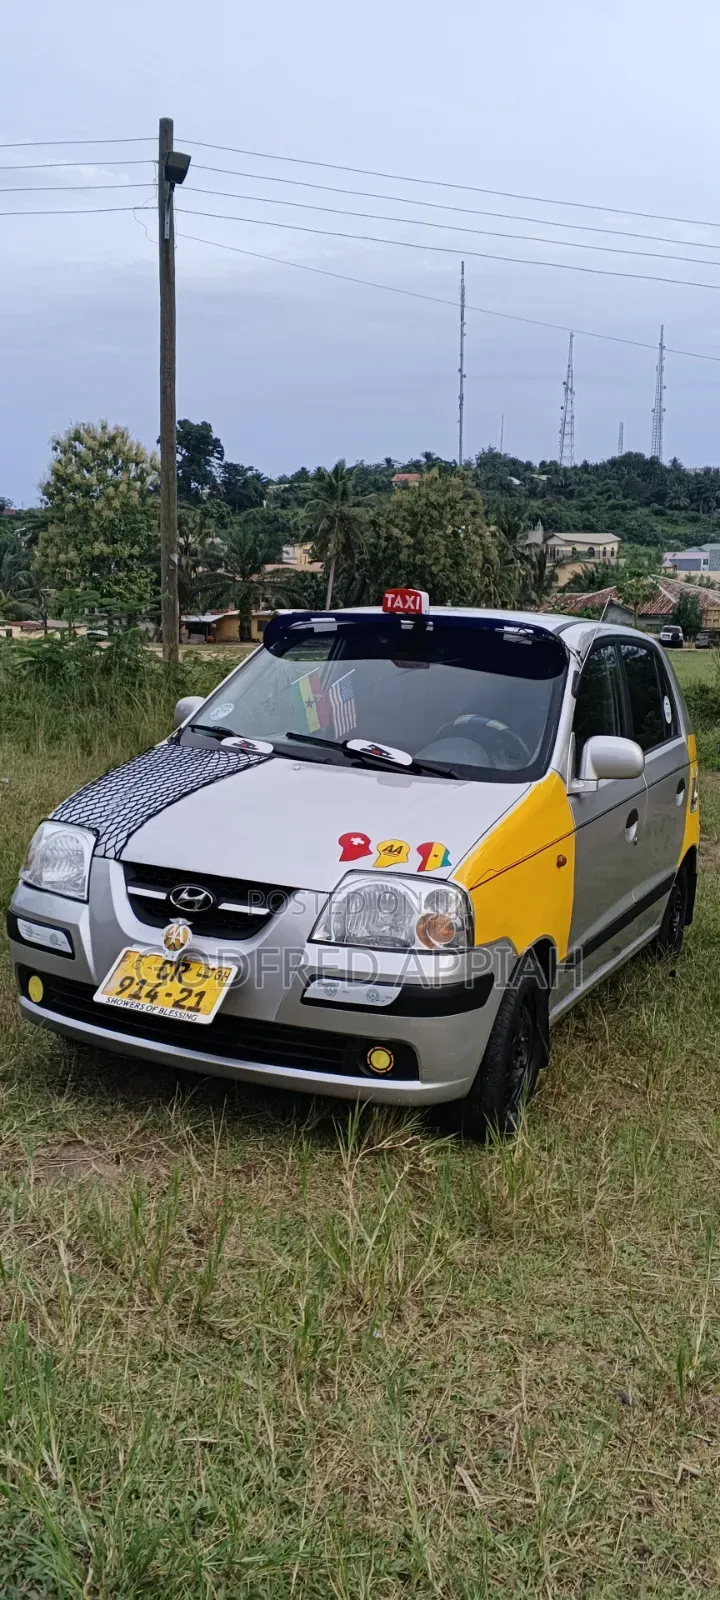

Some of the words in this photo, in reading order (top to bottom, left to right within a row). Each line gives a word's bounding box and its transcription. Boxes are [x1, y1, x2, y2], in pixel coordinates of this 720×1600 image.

[385, 594, 420, 610] TAXI
[382, 844, 403, 855] AA
[156, 959, 191, 983] CR
[213, 970, 231, 982] GH
[105, 997, 145, 1012] SHOWERS
[145, 1005, 157, 1013] OF
[158, 1007, 199, 1022] BLESSING
